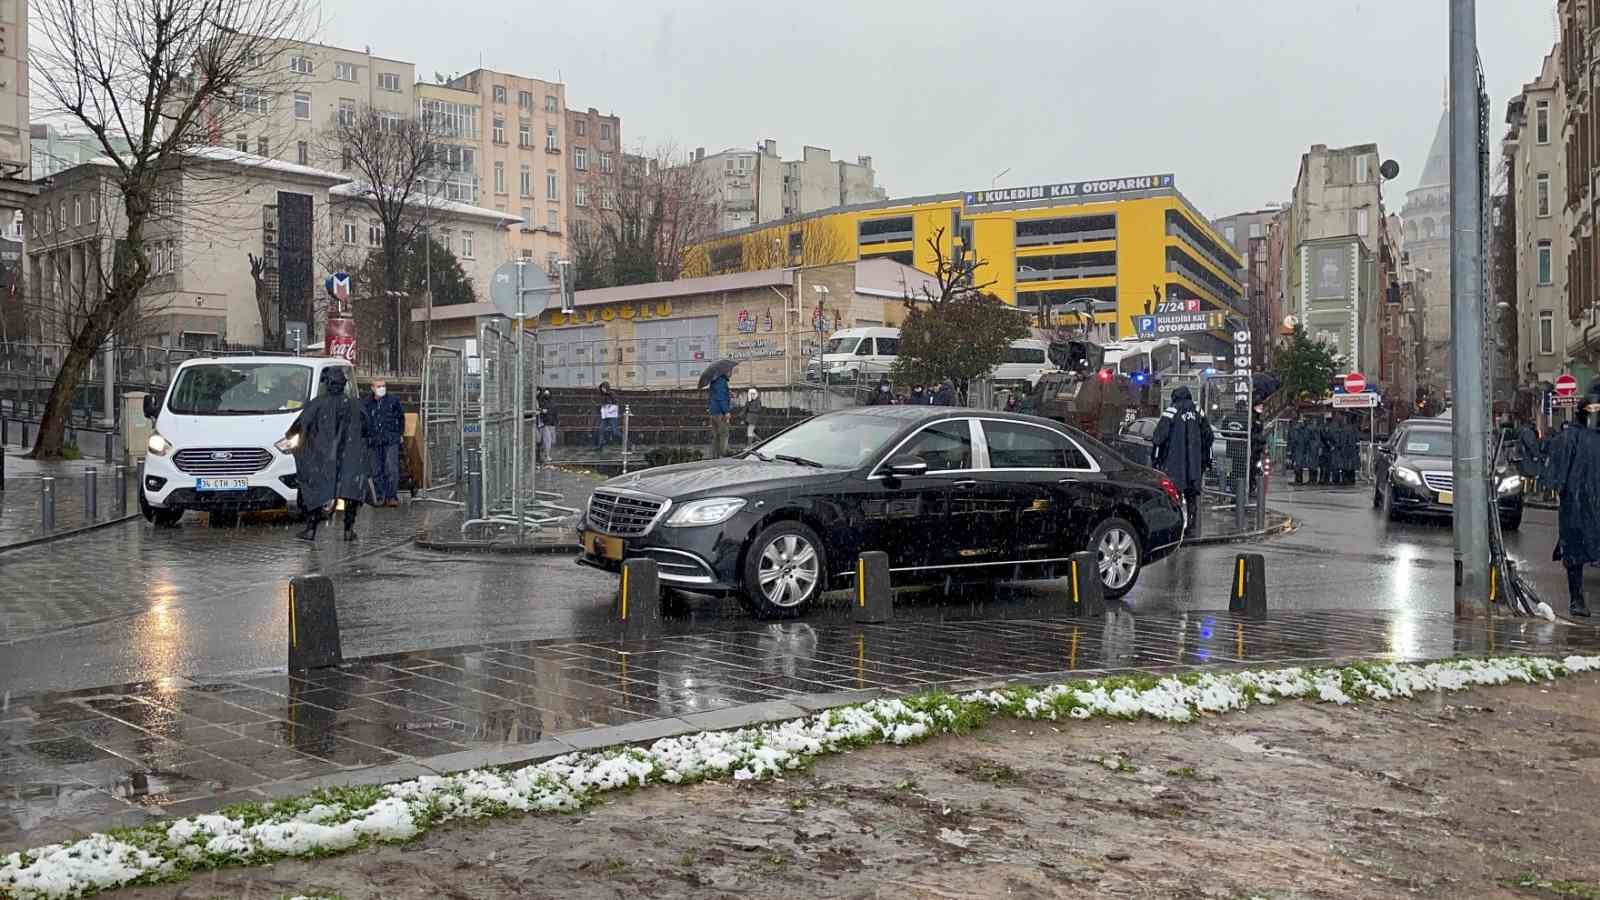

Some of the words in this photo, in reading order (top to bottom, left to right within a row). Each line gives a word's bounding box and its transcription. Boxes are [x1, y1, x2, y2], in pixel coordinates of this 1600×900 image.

[1051, 184, 1076, 196] KAT
[1082, 176, 1151, 194] OTOPARKI
[1158, 301, 1184, 313] 7/24
